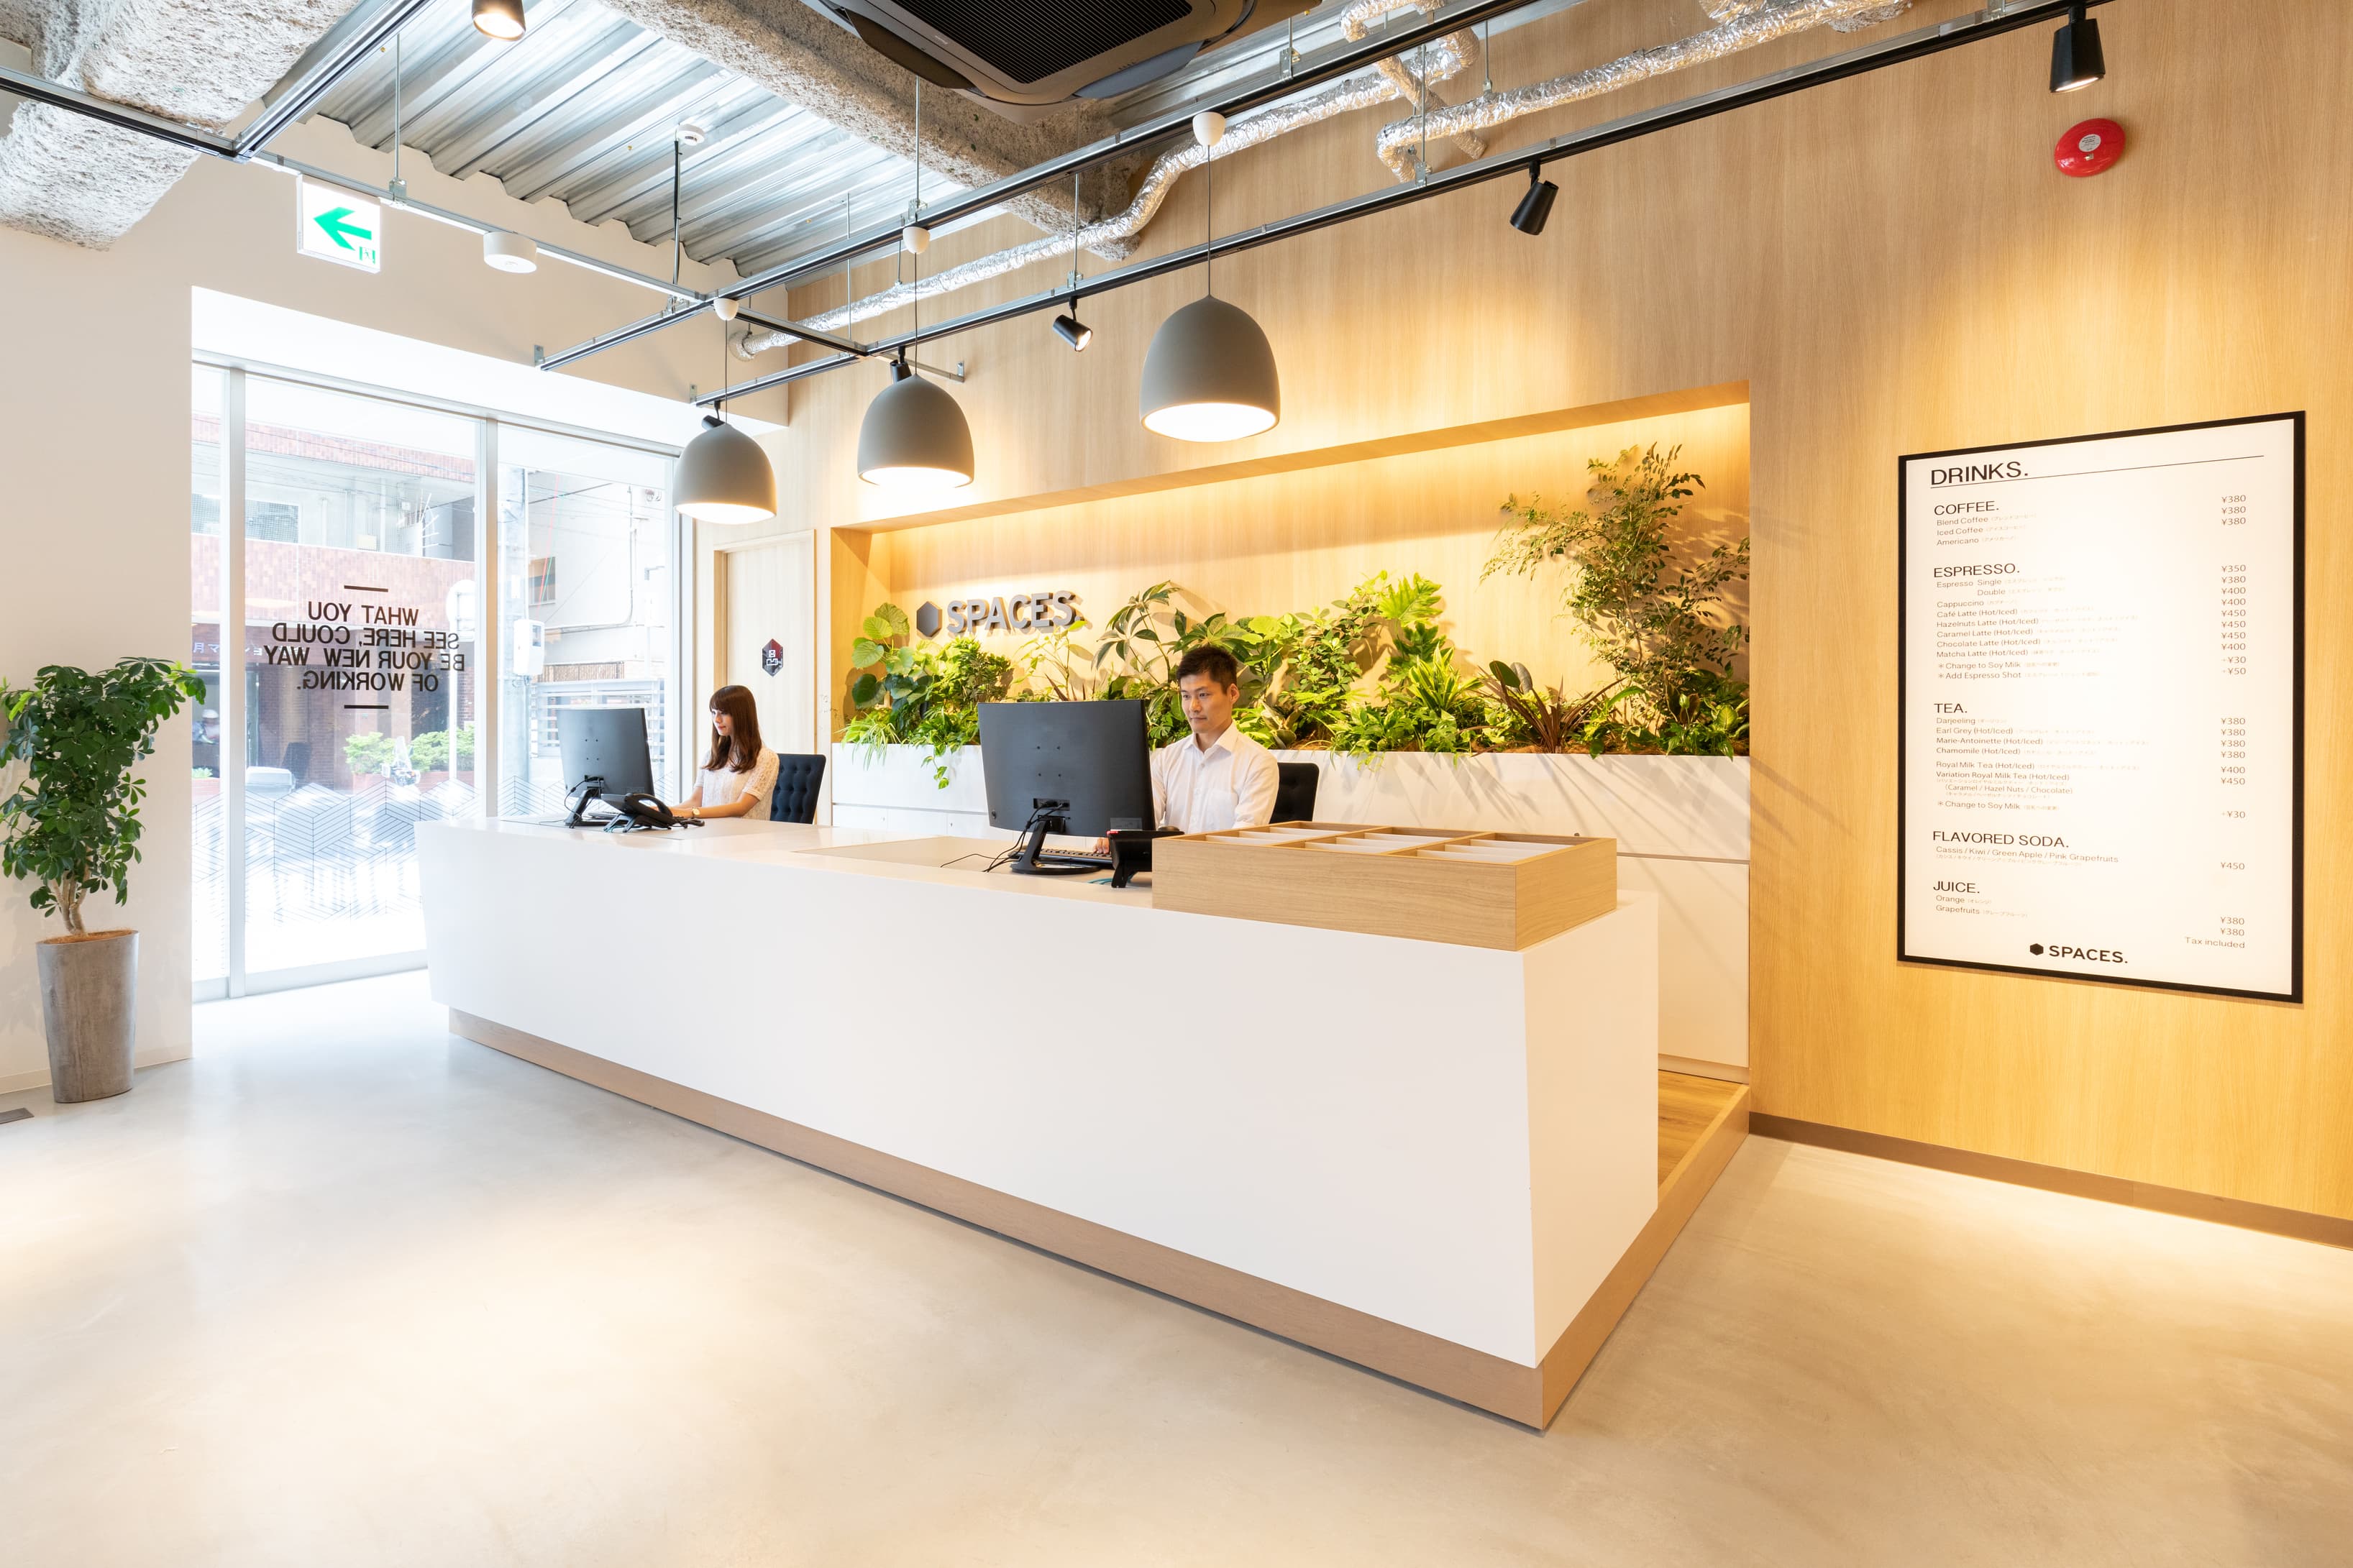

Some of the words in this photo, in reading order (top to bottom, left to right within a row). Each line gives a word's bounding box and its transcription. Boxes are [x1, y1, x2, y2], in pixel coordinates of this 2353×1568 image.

[1930, 460, 2029, 485] DRINKS.
[2221, 494, 2247, 504] ¥380
[1934, 500, 1999, 515] COFFEE.
[2221, 505, 2247, 515] ¥380
[1937, 518, 1959, 526] Blend
[2221, 517, 2247, 526] ¥380
[1936, 538, 1980, 546] Americano
[1933, 563, 2021, 579] ESPRESSO.
[2221, 564, 2247, 573] ¥350
[1977, 578, 2002, 587] Single
[2221, 575, 2247, 584] ¥380
[1937, 600, 1985, 609] Cappuccino
[2221, 597, 2247, 606] ¥400
[947, 590, 1084, 634] SPACES.
[2221, 609, 2247, 618] ¥450
[1998, 618, 2039, 626] (Hot/Iced)
[2221, 620, 2247, 628] ¥450
[1993, 628, 2034, 636] (Hot/Iced)
[2001, 638, 2041, 646] (Hot/Iced)
[1988, 661, 2004, 670] Soy
[1964, 671, 2001, 681] Espresso
[1934, 702, 1968, 714] TEA.
[1936, 717, 1976, 725] Darjeeling
[2220, 717, 2246, 725] ¥380
[1952, 727, 1973, 735] Grey
[2221, 739, 2246, 748] ¥380
[1936, 761, 1958, 769] Royal
[2221, 766, 2246, 774] ¥400
[1972, 771, 1993, 780] Royal
[2030, 786, 2073, 794] Chocolate)
[1987, 802, 2004, 811] Soy
[1932, 830, 2015, 845] FLAVORED
[2018, 835, 2070, 848] SODA.
[1936, 845, 1963, 854] Cassis
[2019, 851, 2043, 859] Apple
[2069, 853, 2119, 863] Grapefruits
[1932, 880, 1980, 894] JUICE.
[1935, 894, 1965, 904] Orange
[1935, 904, 1980, 914] Grapefruits
[2220, 916, 2245, 925] ¥380
[2220, 927, 2245, 937] ¥380
[2205, 939, 2245, 948] included
[2048, 944, 2129, 964] SPACES.
